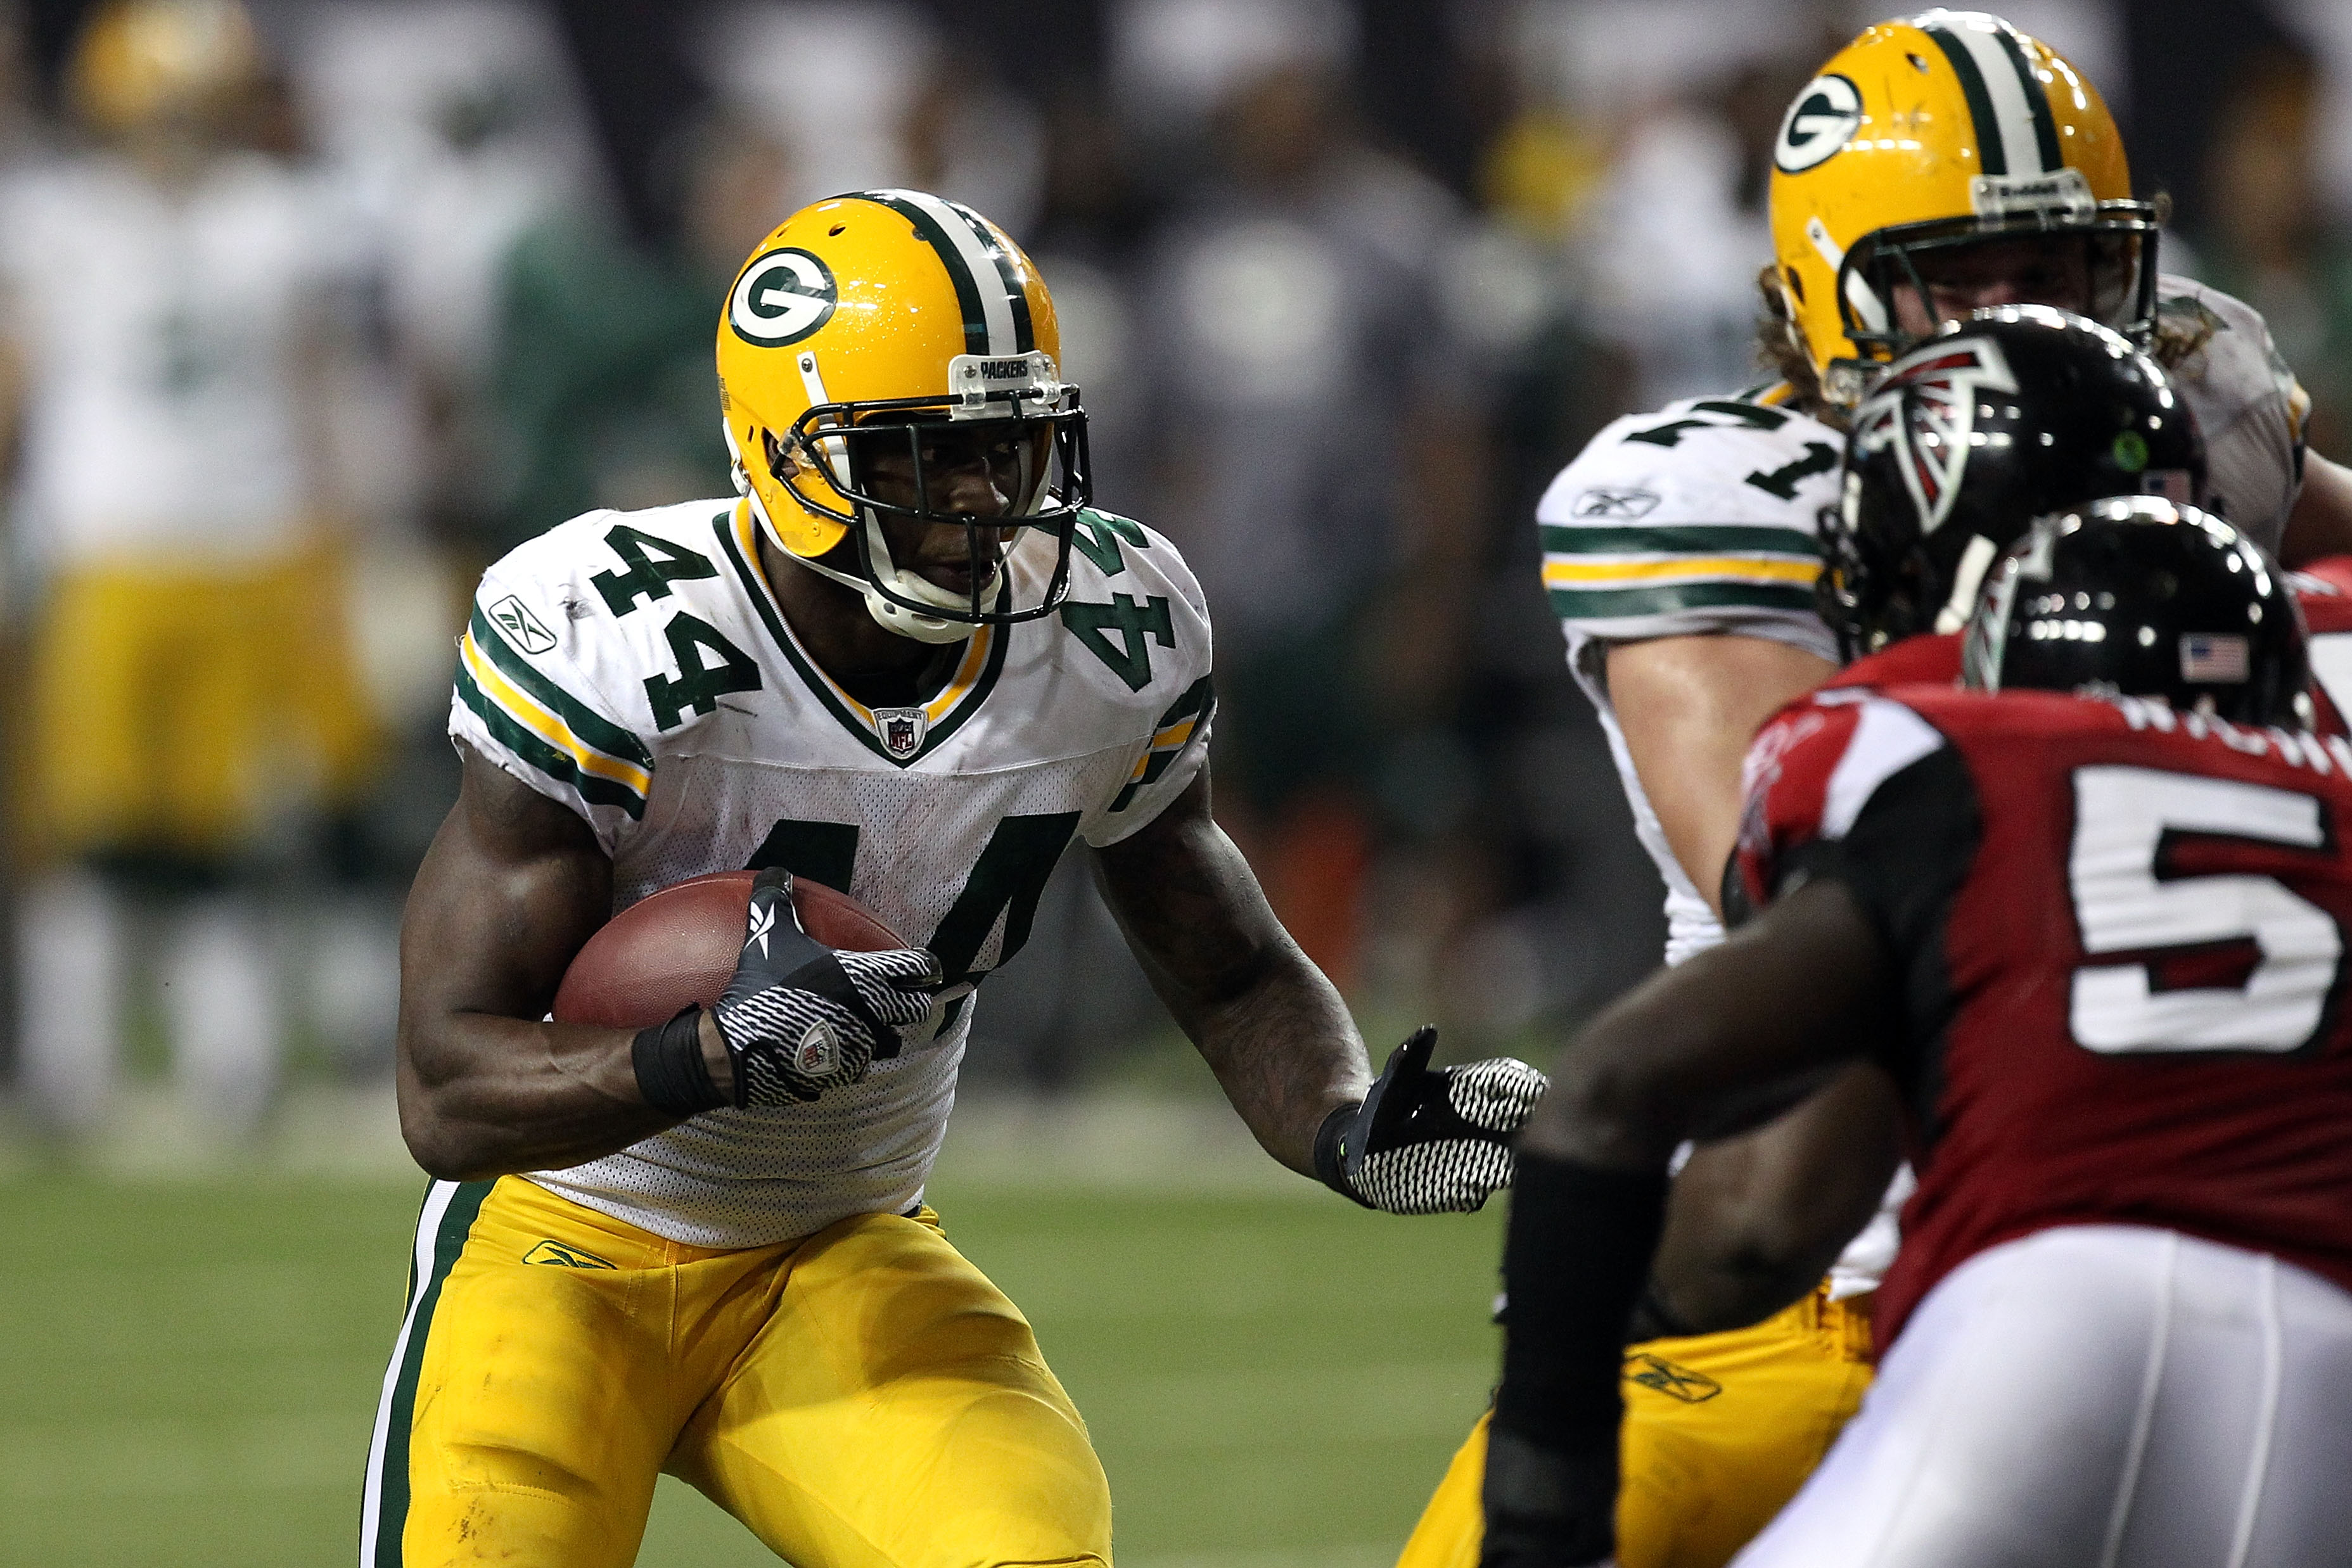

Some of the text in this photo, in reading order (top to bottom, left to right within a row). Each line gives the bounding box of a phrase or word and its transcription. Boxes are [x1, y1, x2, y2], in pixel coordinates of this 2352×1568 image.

[980, 360, 1028, 379] PACKERS
[590, 525, 762, 732] 44
[2068, 764, 2343, 1055] 5
